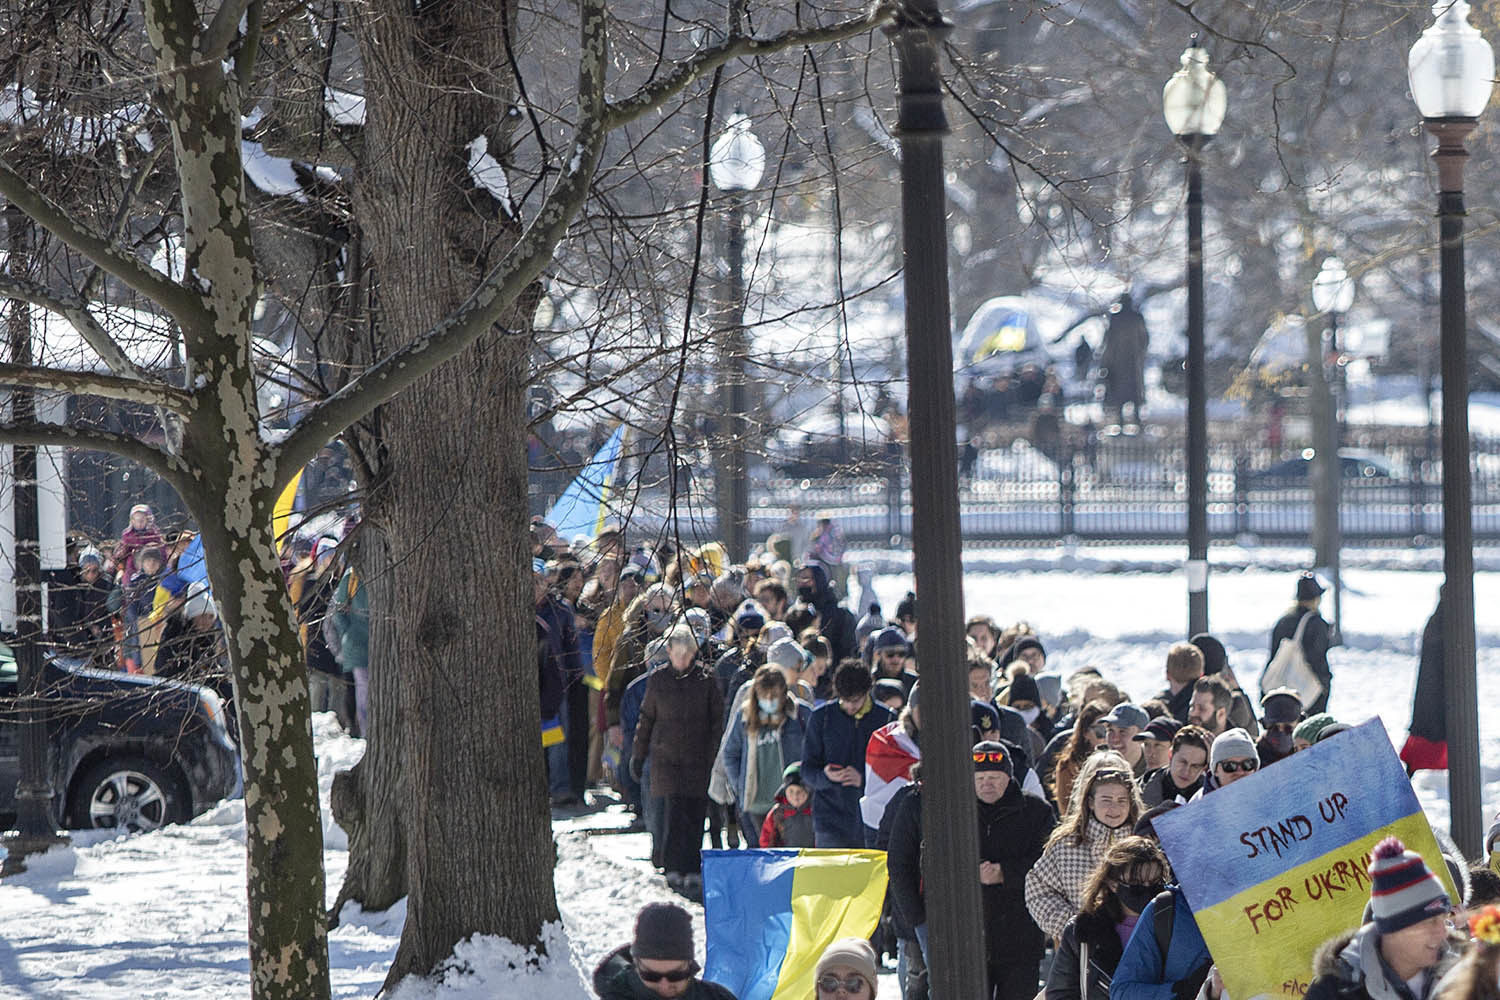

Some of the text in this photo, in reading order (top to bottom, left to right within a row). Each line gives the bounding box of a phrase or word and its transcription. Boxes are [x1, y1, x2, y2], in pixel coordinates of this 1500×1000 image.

[1240, 792, 1348, 858] STAND UP
[1243, 886, 1298, 934] FOR
